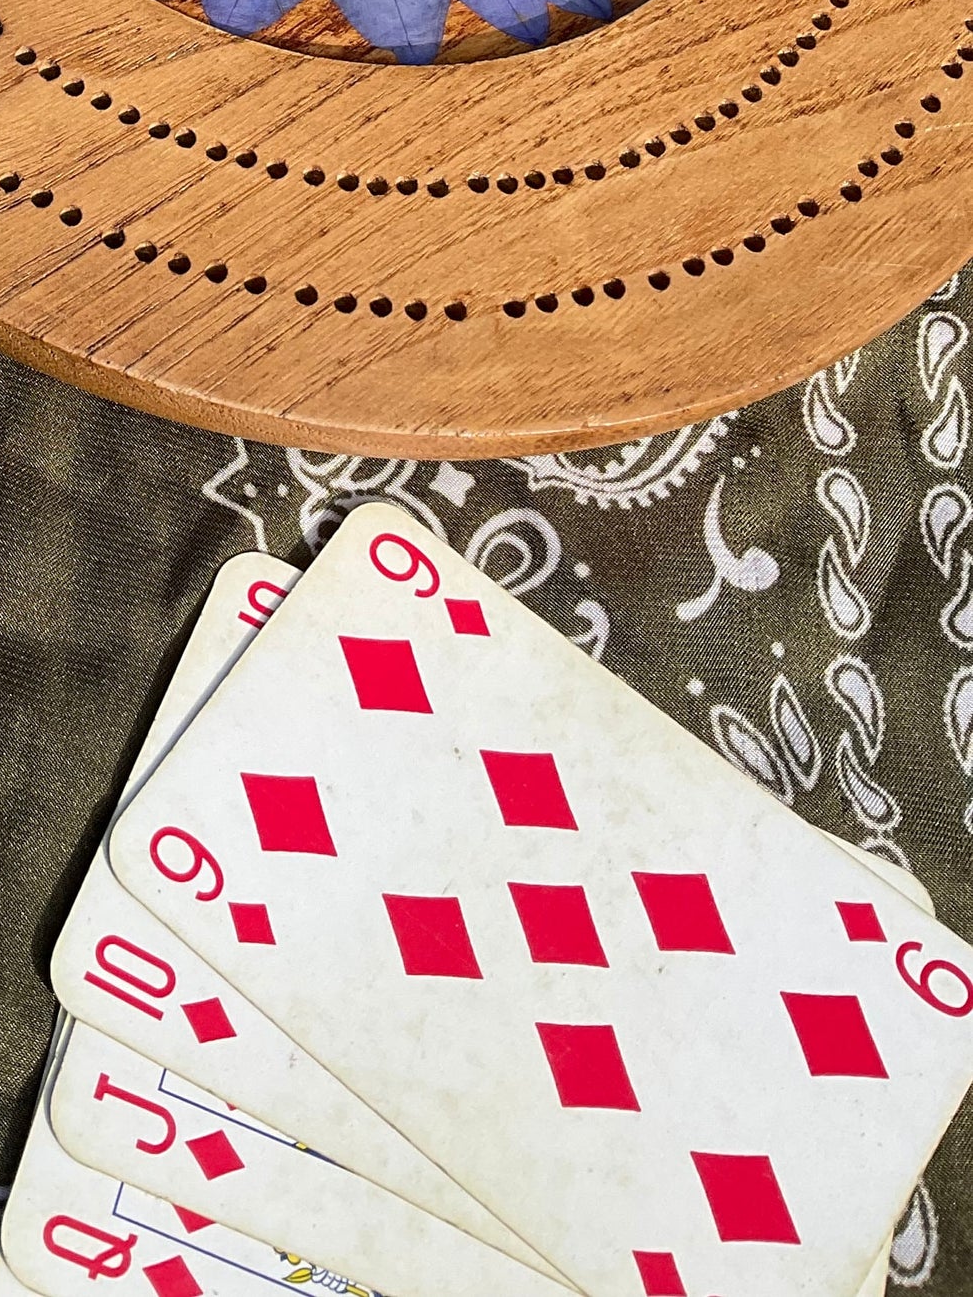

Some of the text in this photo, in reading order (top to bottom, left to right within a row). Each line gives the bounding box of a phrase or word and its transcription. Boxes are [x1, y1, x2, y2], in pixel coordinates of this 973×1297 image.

[369, 533, 441, 598] 9
[150, 826, 225, 902] 9
[83, 934, 177, 1021] 10
[93, 1072, 177, 1155] J
[42, 1214, 138, 1281] Q
